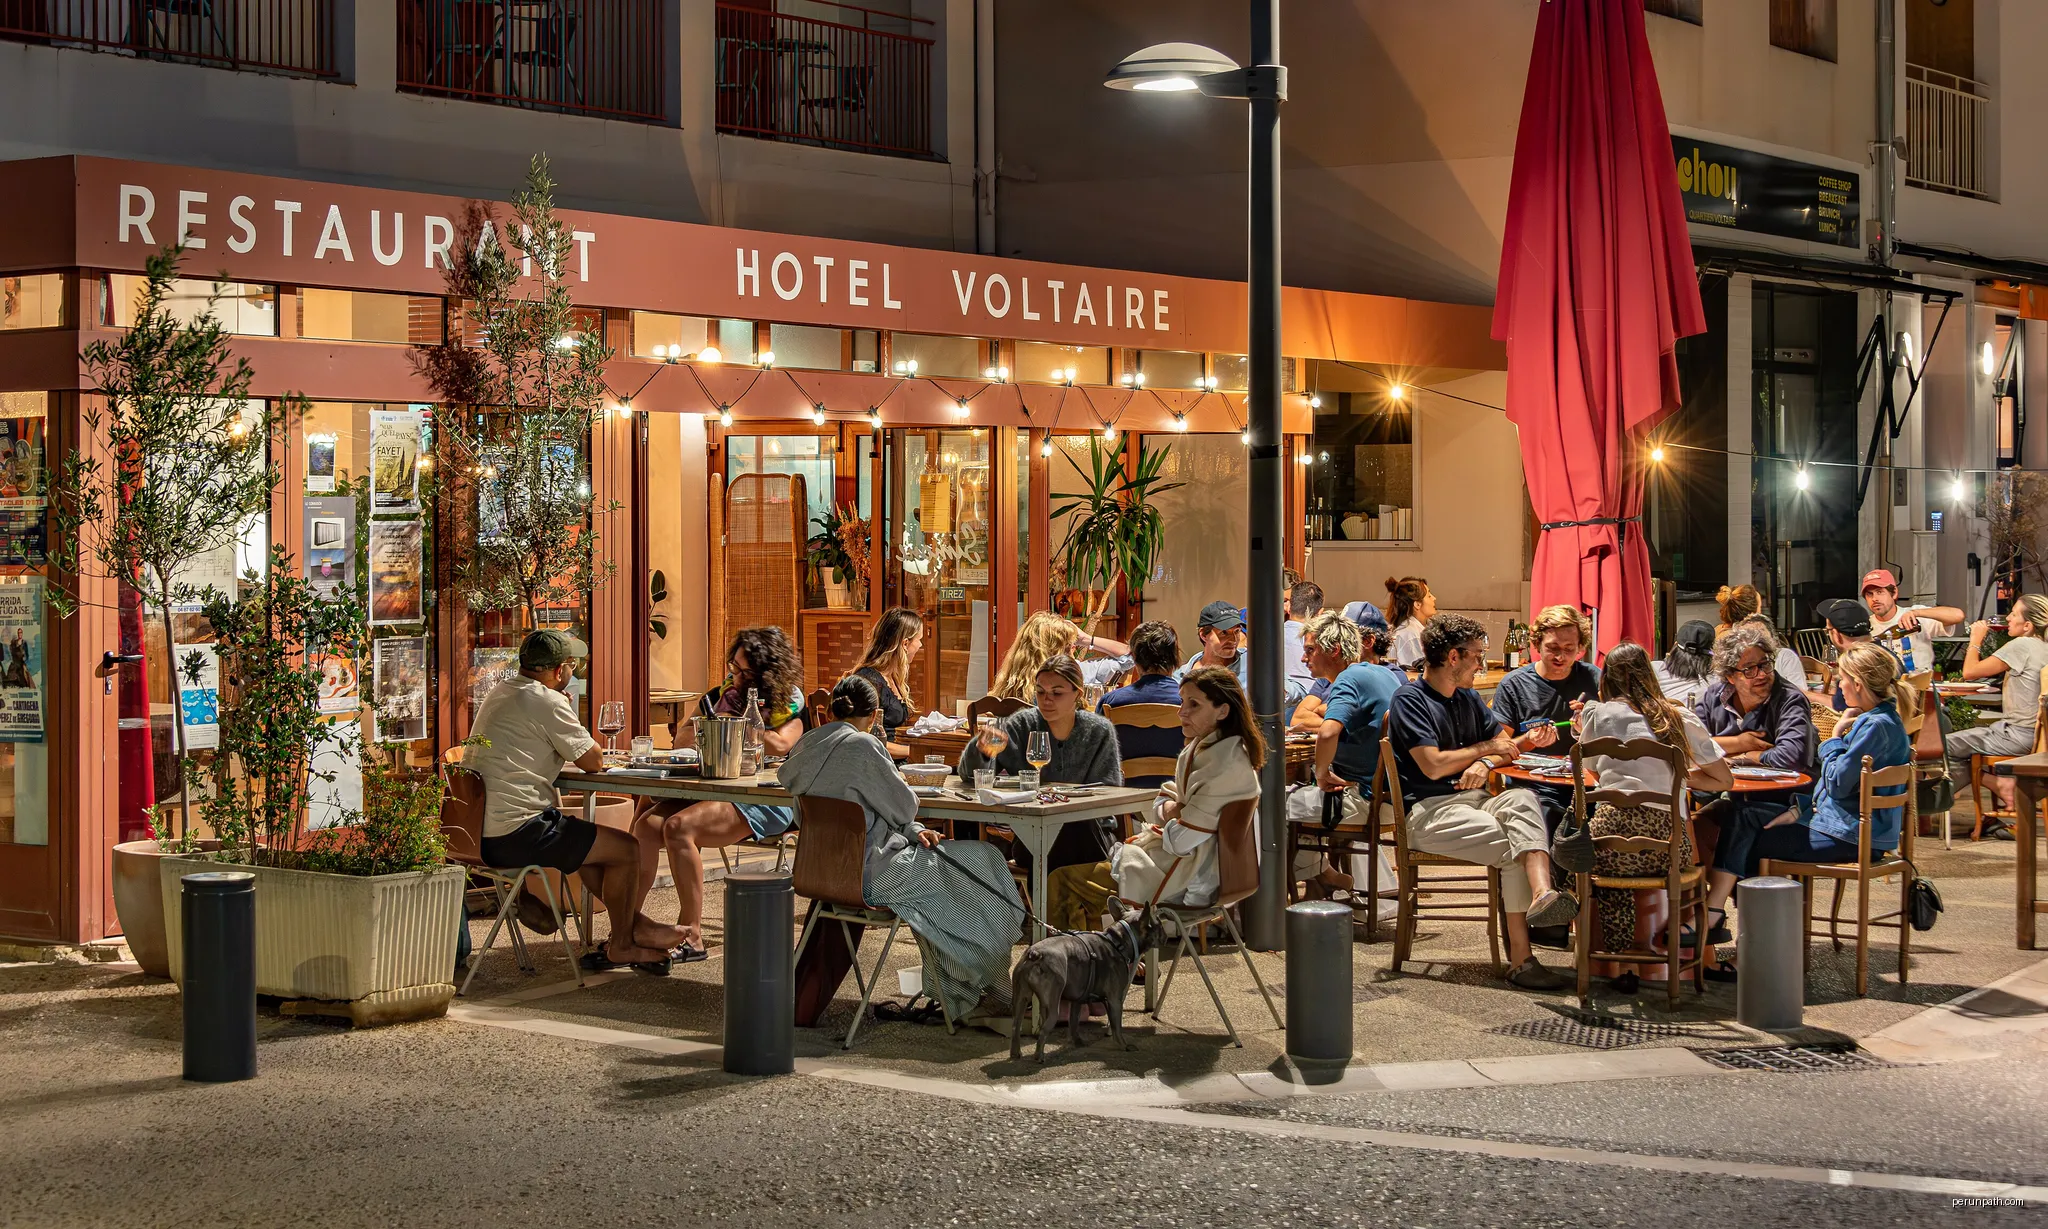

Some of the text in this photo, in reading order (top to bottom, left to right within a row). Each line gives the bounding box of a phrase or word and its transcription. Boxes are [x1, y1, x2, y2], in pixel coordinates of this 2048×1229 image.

[1818, 175, 1852, 192] COFFEE SHOP
[1818, 191, 1847, 206] BREAKFAST
[1818, 206, 1841, 219] BRUNCH
[118, 184, 596, 283] RESTAURANT
[1818, 221, 1837, 234] LUNCH
[736, 248, 1170, 331] HOTEL VOLTAIRE
[377, 446, 401, 455] FAYET
[941, 589, 964, 599] TIREZ
